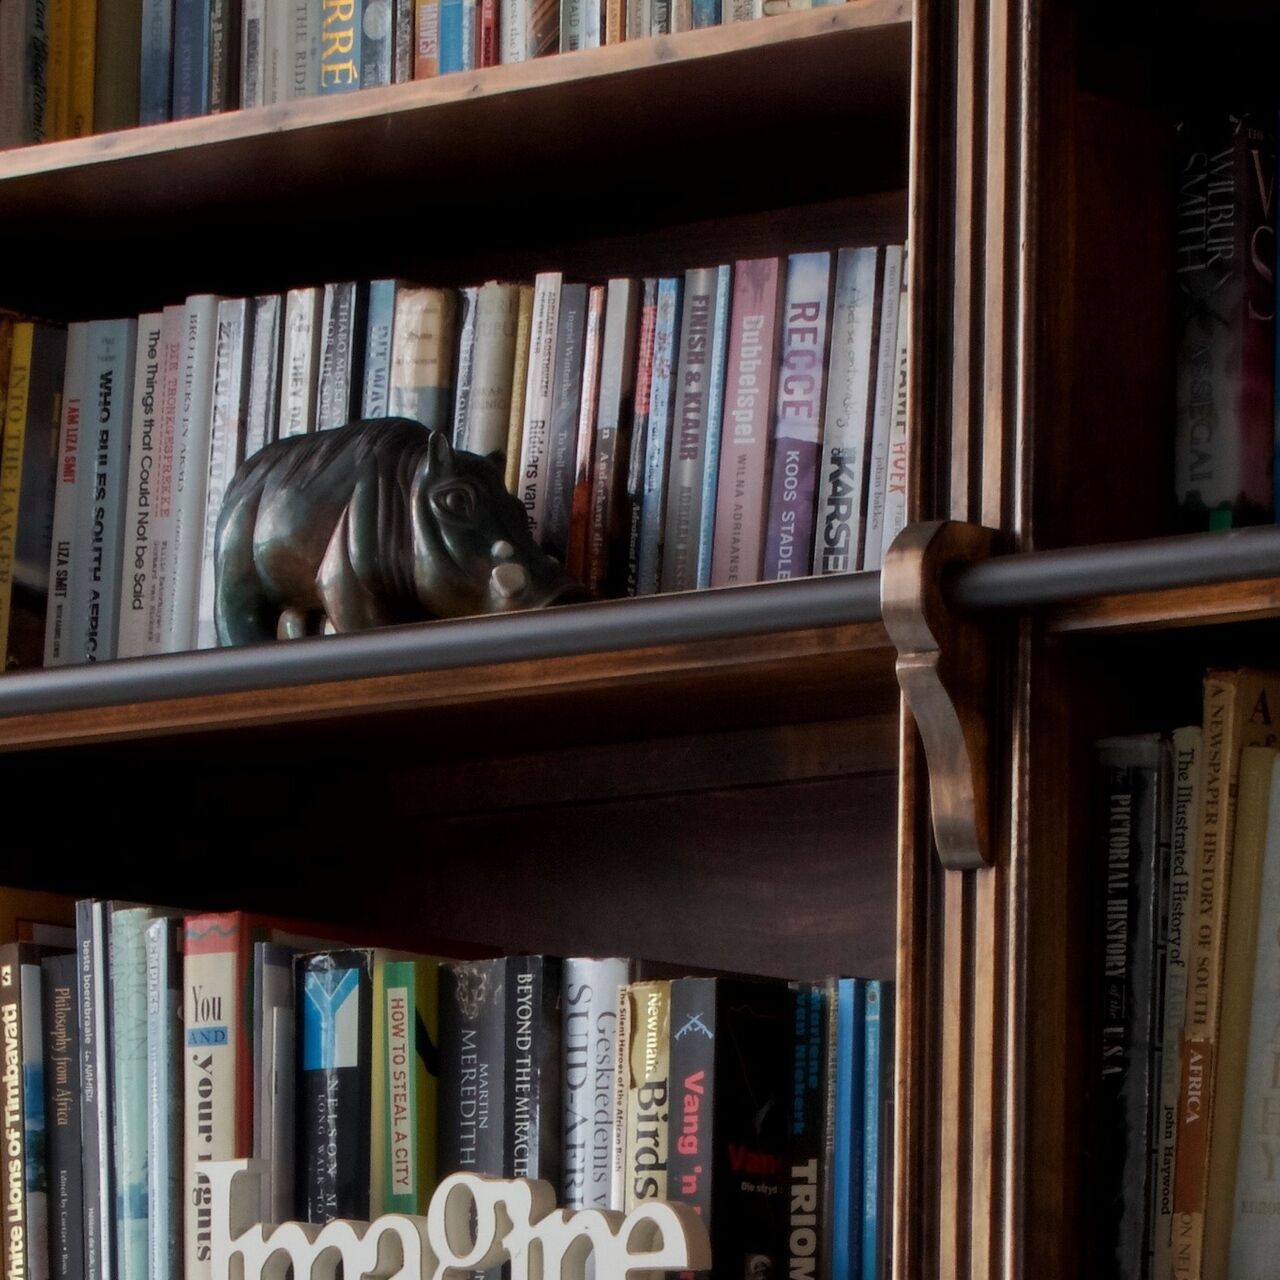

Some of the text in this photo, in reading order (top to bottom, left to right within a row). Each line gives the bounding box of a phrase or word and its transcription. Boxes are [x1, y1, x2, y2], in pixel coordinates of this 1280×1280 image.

[679, 295, 709, 461] FINISH KLAAR
[782, 302, 820, 501] RECCE KOOS
[131, 329, 161, 609] The Things that Could Not be Said
[1, 1004, 19, 1128] Timbavati
[194, 1054, 216, 1142] your
[391, 998, 408, 1186] HOW TO STEAL A CITY
[460, 1029, 477, 1164] MEREDITH
[479, 1063, 489, 1129] MARTIN
[513, 974, 532, 1176] BEYOND THE MIRACLE
[677, 1071, 704, 1155] Vang
[5, 1128, 22, 1157] of
[6, 1160, 23, 1224] Lions
[635, 1078, 668, 1200] Birds
